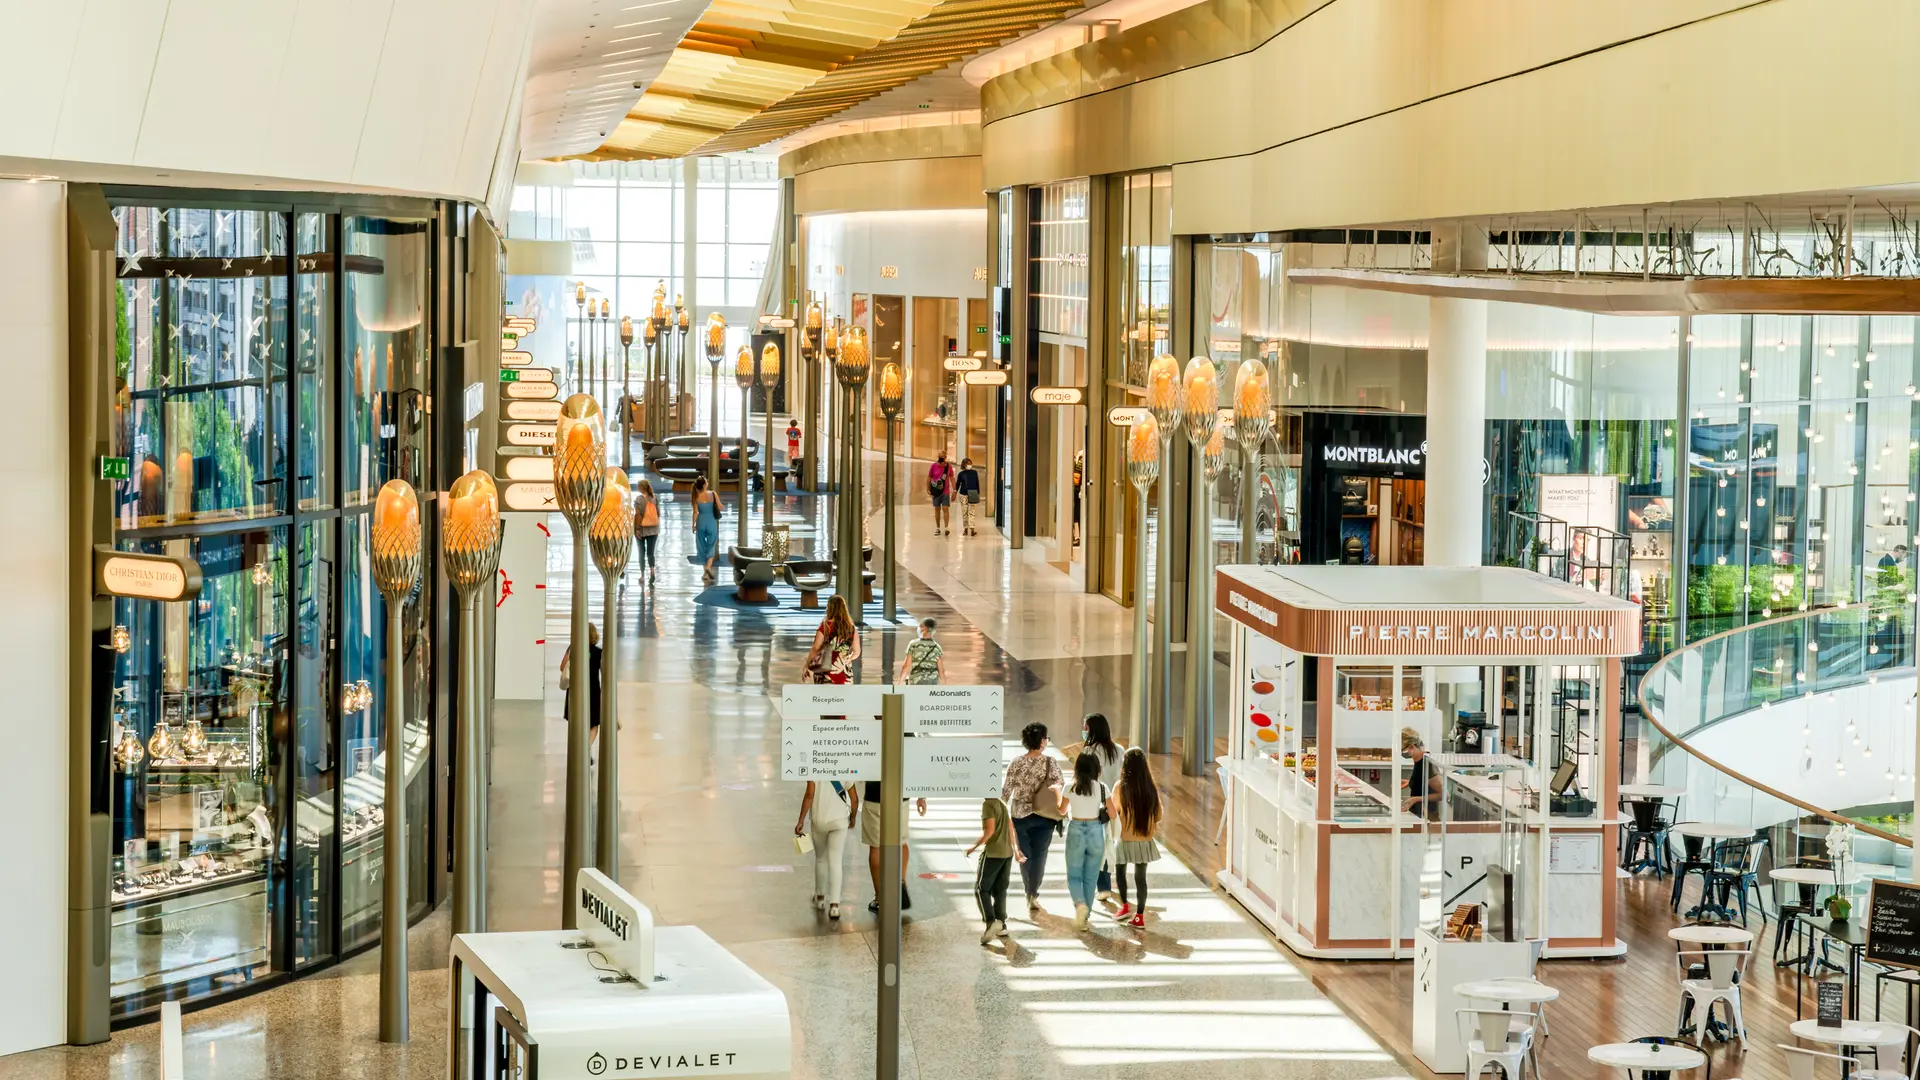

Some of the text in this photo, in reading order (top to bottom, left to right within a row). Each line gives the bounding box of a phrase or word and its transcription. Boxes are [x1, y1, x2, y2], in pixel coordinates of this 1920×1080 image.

[1045, 392, 1071, 402] maje
[1324, 446, 1420, 465] MONTBLANC
[520, 486, 555, 494] MAUBO
[109, 567, 178, 582] CHRISTIAN DIOR
[135, 580, 153, 588] PARIS
[1350, 625, 1614, 640] PIERRE MARCOLINI
[812, 695, 844, 704] Réception
[812, 724, 860, 733] Espace enfants
[812, 757, 838, 765] Rooftop
[930, 755, 971, 763] FAUCHON
[812, 767, 836, 776] Parking
[837, 767, 850, 775] sud
[1461, 856, 1473, 869] P
[581, 887, 628, 941] DEVIALET
[162, 913, 215, 932] MAUBOUSSIN
[615, 1052, 736, 1070] DEVIALET
